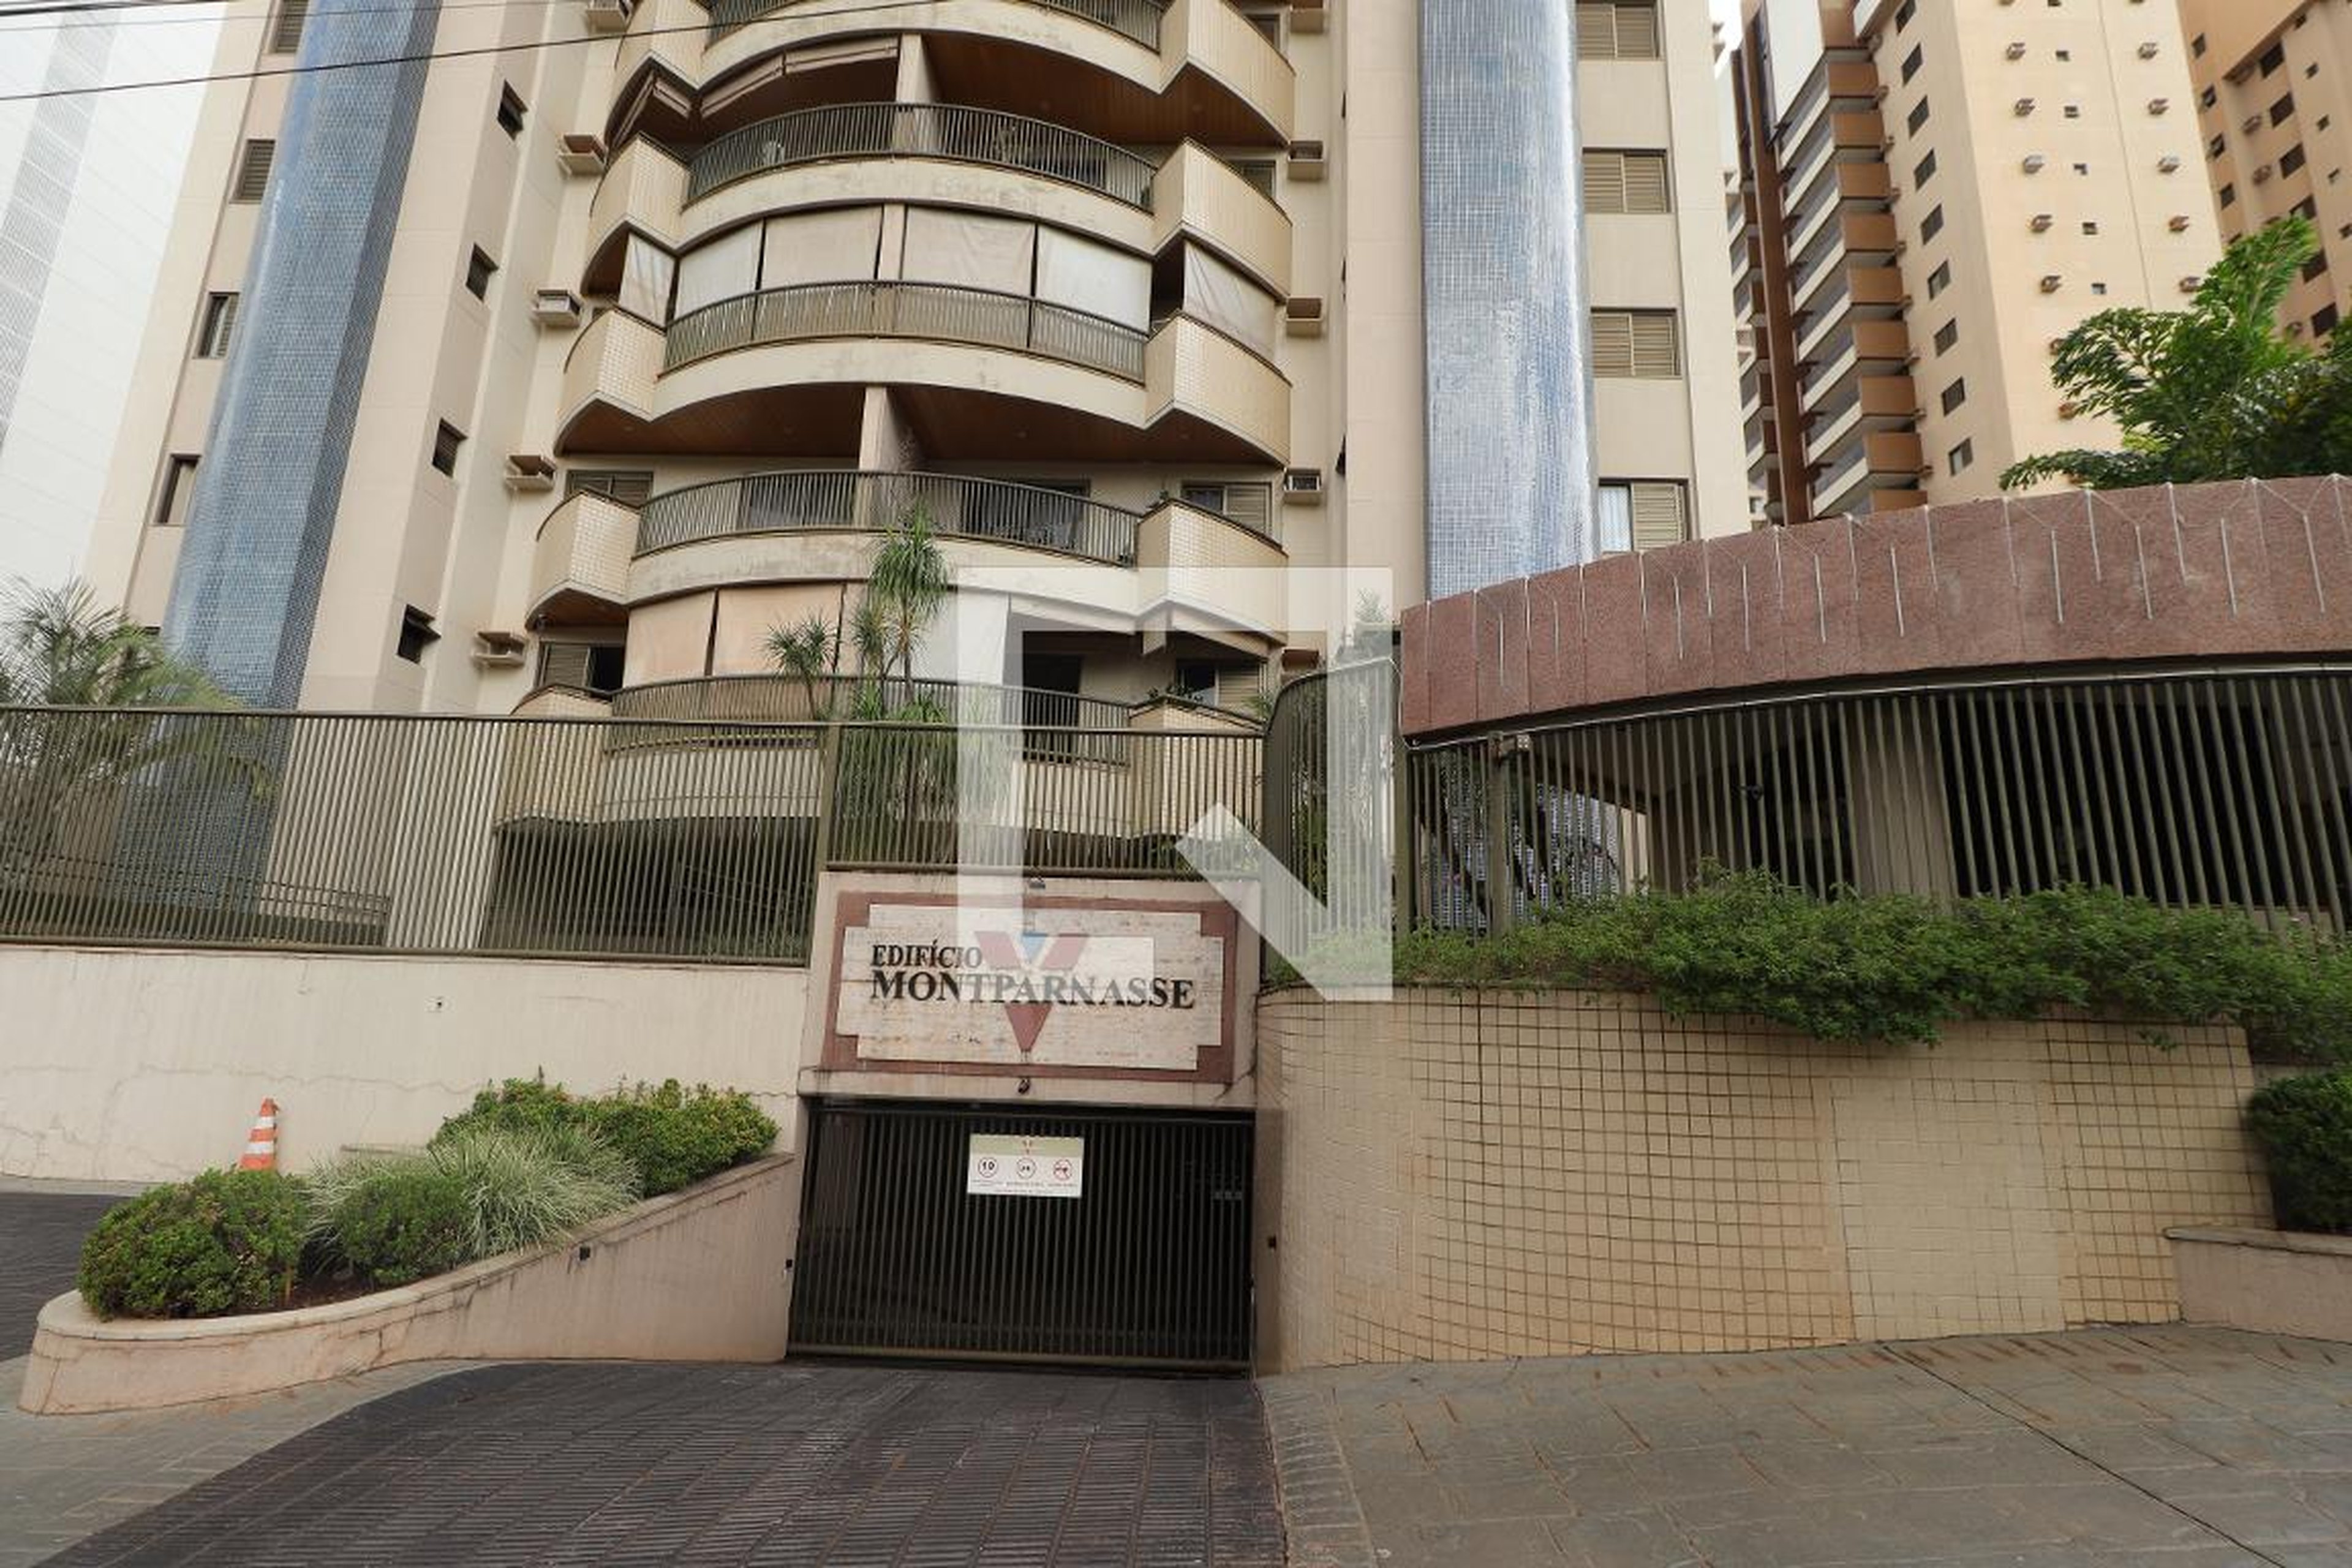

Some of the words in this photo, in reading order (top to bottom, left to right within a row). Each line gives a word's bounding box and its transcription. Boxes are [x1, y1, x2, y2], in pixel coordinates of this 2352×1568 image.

[870, 939, 982, 968] EDIFÍCIO
[870, 970, 1194, 1009] MONTPARNASSE
[981, 1161, 995, 1170] 10
